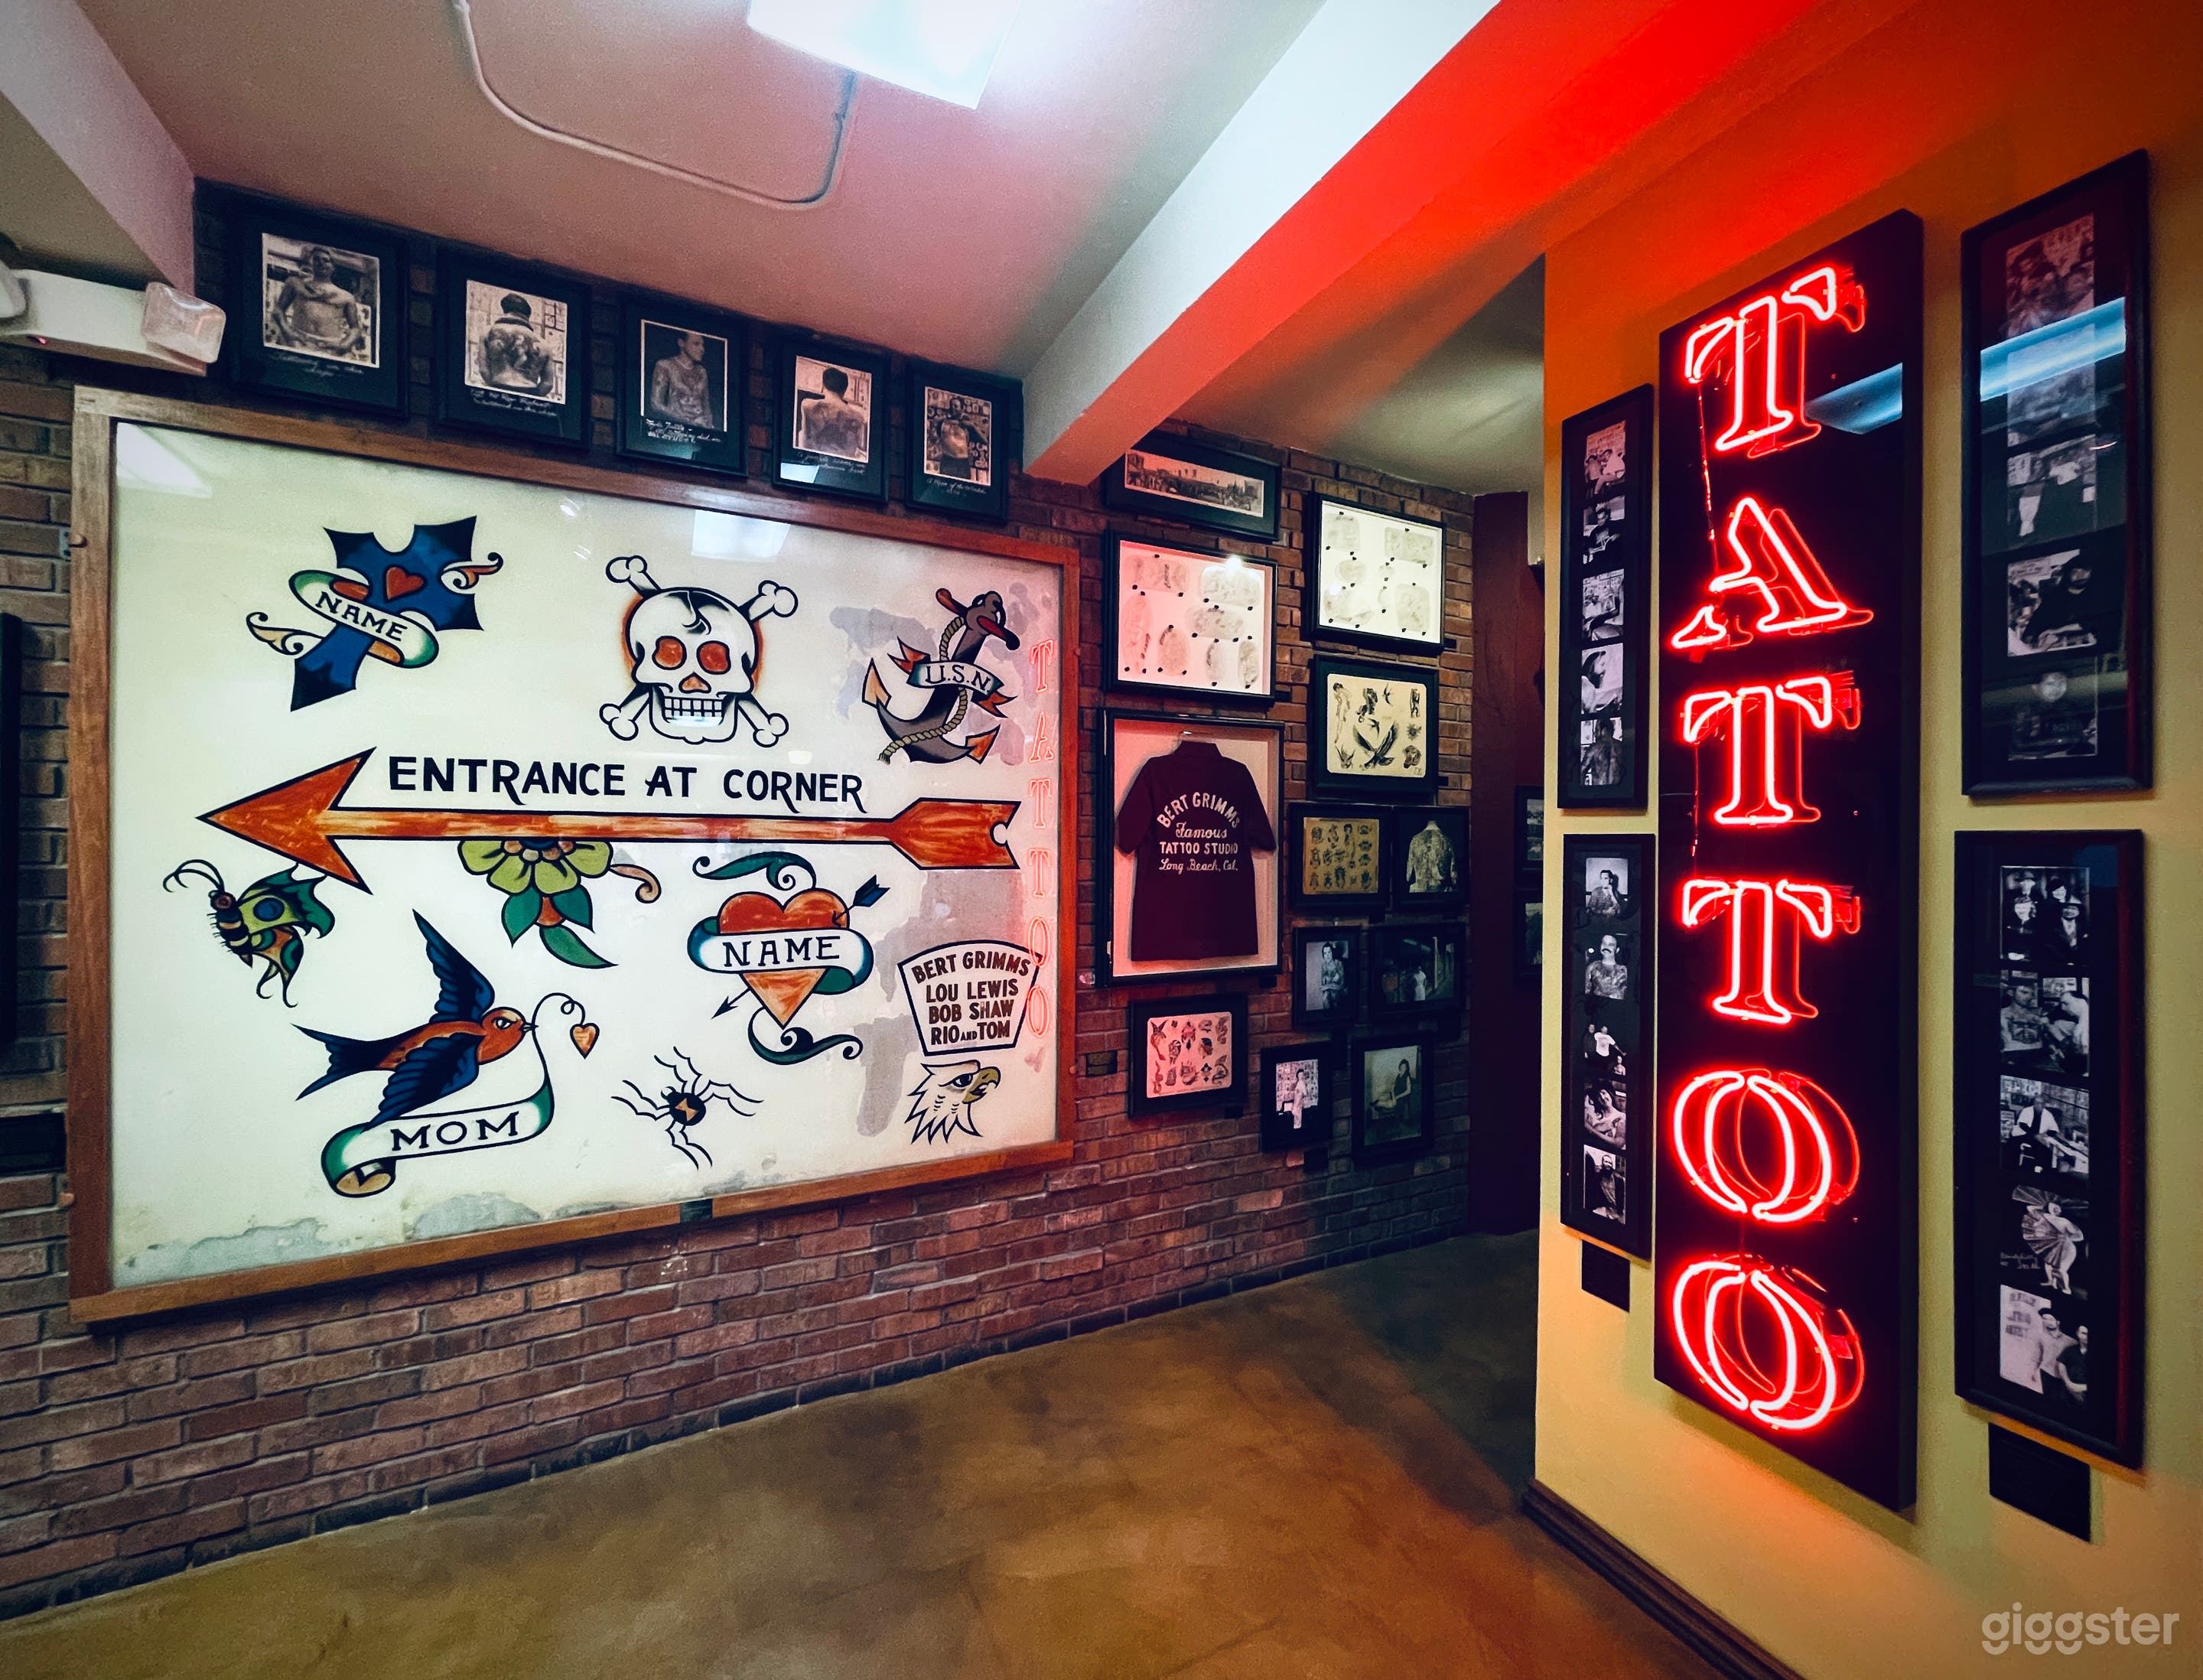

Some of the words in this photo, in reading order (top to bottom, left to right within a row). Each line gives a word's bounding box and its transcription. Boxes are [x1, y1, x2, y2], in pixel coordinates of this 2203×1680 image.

[315, 591, 408, 642] NAME
[389, 756, 626, 806] ENTRANCE
[645, 766, 697, 797] AT
[723, 769, 867, 814] CORNER
[1157, 794, 1189, 828] BERT
[1192, 792, 1240, 828] GRIMMS
[1175, 821, 1228, 838] Famous
[1159, 842, 1200, 855] TATTOO
[1203, 842, 1238, 855] STUDIO
[1671, 265, 1854, 1432] TATTOO
[1159, 858, 1184, 874] Long
[722, 936, 841, 967] NAME
[911, 954, 957, 984] BERT
[962, 951, 1031, 976] GRIMMS
[926, 983, 958, 1003] LOU
[967, 978, 1019, 1000] LEWIS
[929, 1004, 962, 1024] BOB
[969, 999, 1014, 1020] SHAW
[931, 1025, 960, 1045] RIO
[977, 1020, 1010, 1040] TOM
[390, 1111, 519, 1151] MOM
